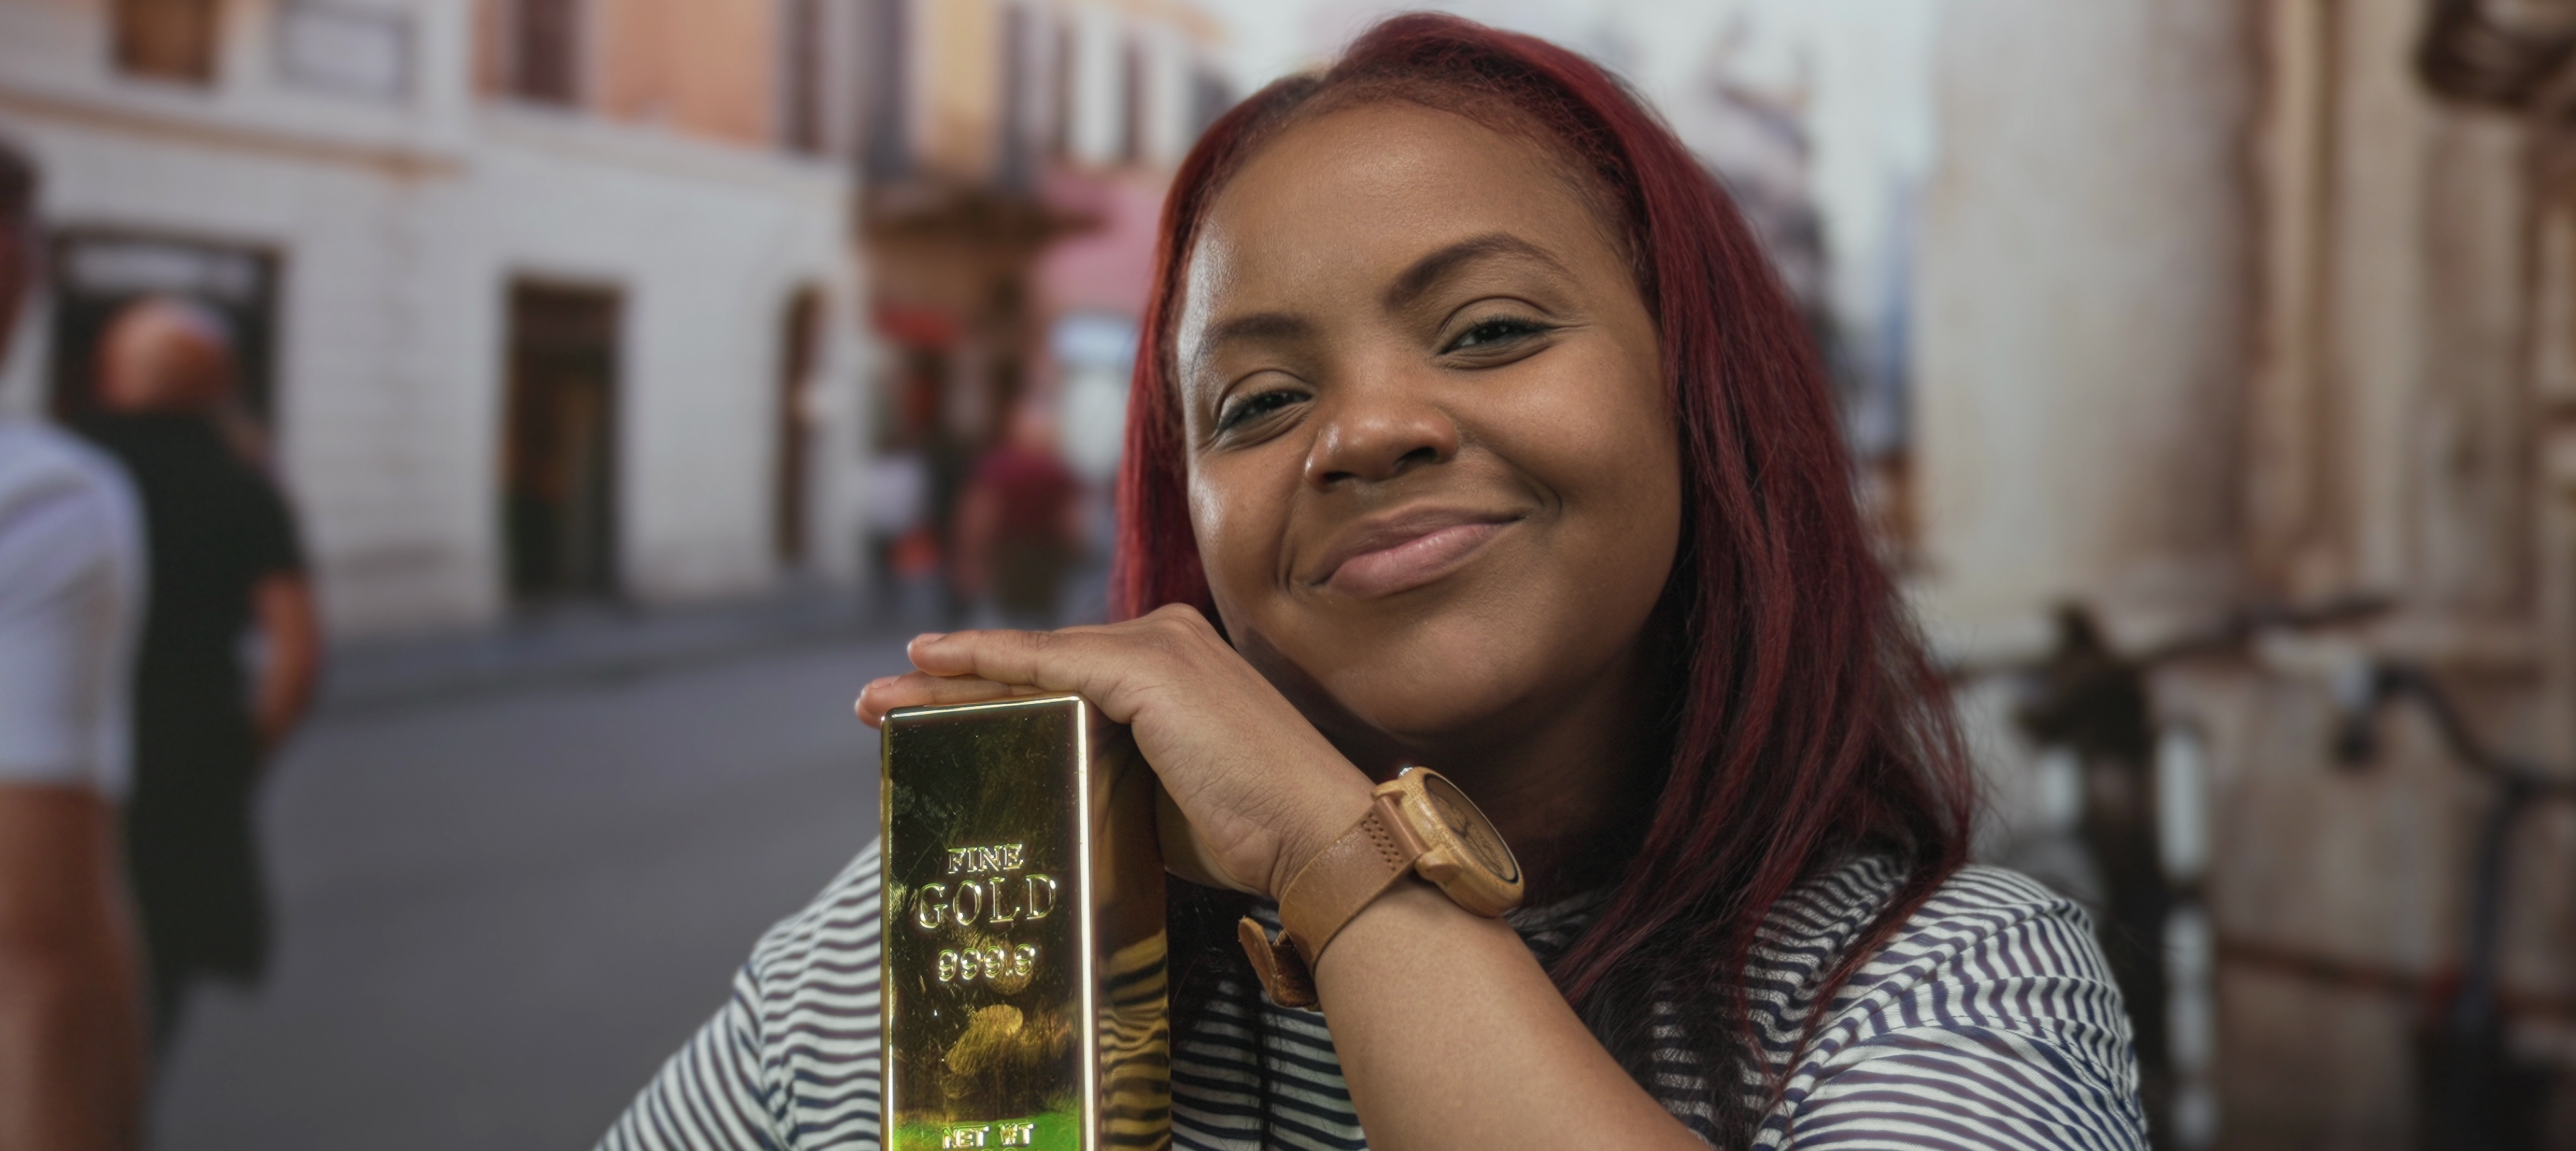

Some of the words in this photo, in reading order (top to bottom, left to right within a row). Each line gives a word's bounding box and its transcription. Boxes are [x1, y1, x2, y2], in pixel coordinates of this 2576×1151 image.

[948, 844, 1022, 874] FINE
[919, 874, 1057, 928] GOLD
[938, 944, 1036, 982] 999.9
[942, 1125, 989, 1148] NET
[998, 1122, 1034, 1146] WT
